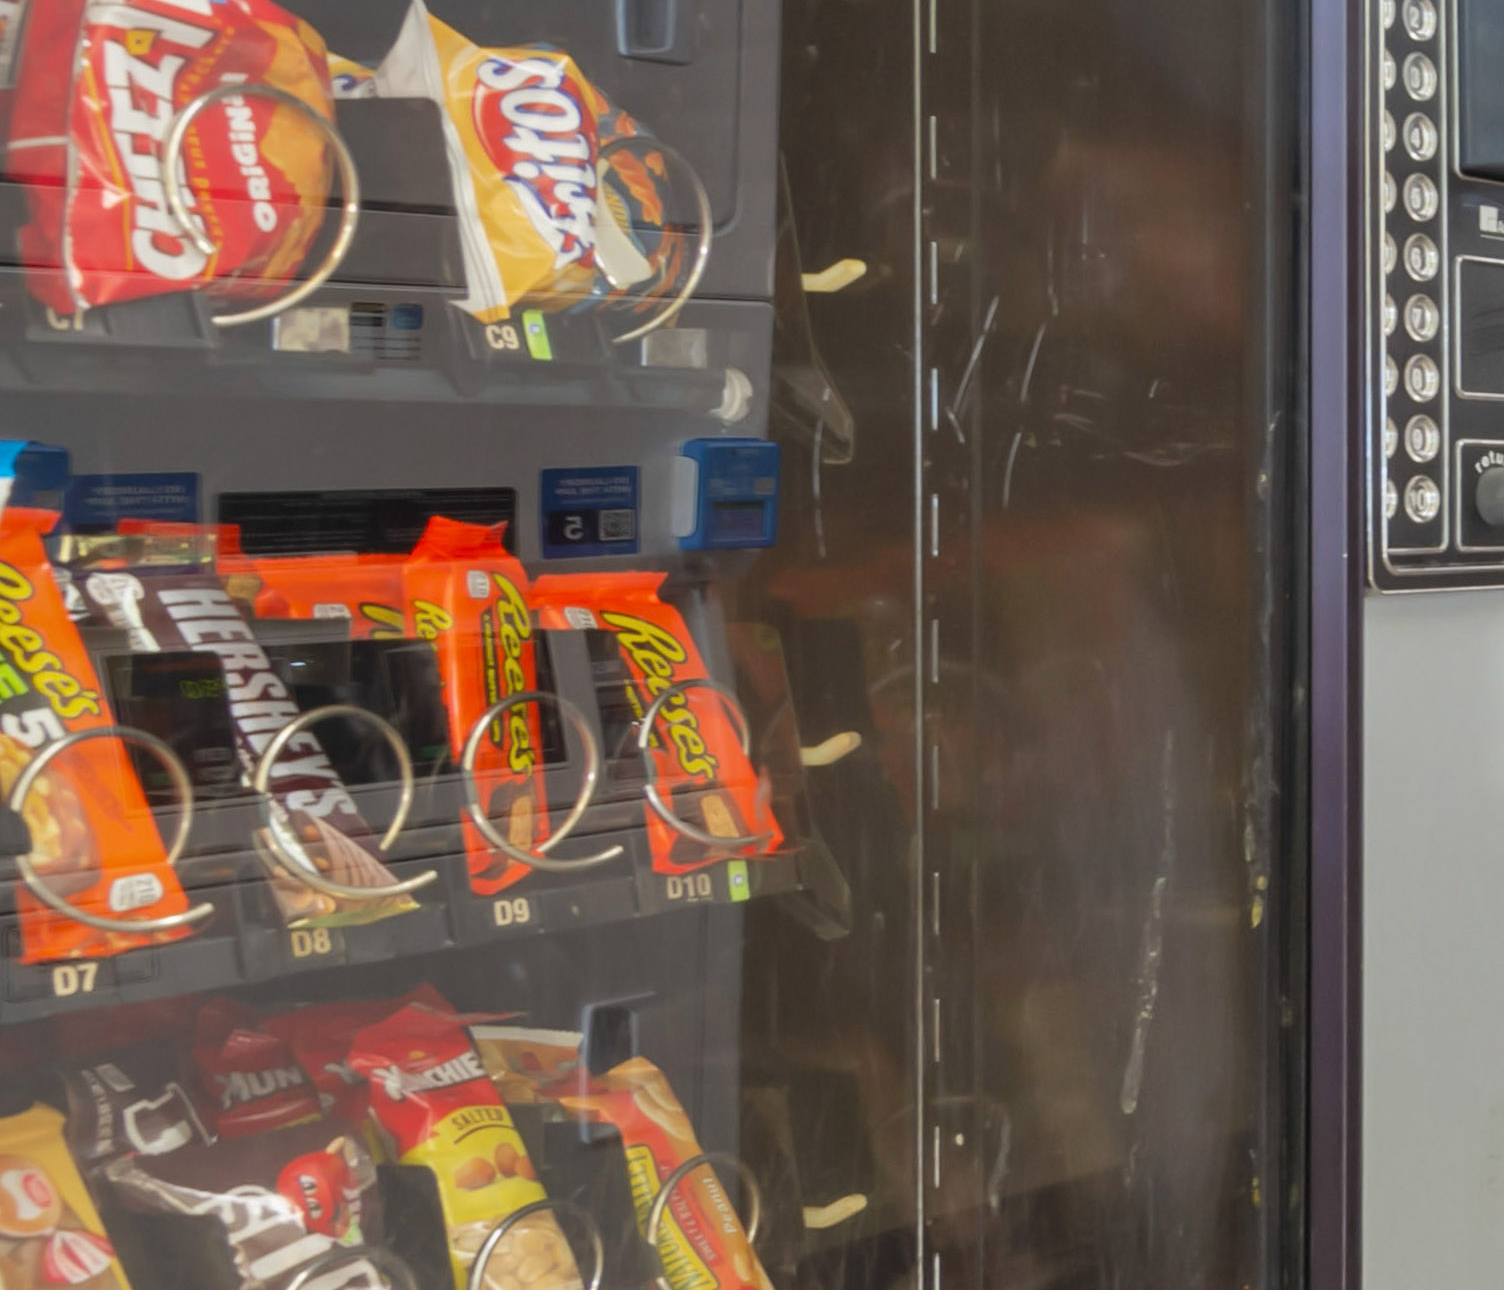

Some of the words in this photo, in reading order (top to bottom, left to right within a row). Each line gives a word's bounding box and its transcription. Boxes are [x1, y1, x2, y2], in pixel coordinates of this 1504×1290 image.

[220, 72, 279, 234] ORIGINL
[476, 57, 600, 271] Fritos
[485, 323, 520, 351] C9
[493, 572, 537, 778] Reese's
[601, 610, 720, 779] Reese's
[156, 587, 364, 818] HERSHEY'S
[666, 872, 712, 900] D10
[493, 897, 532, 926] D9
[290, 927, 332, 958] D8
[52, 961, 100, 999] D7
[450, 1104, 507, 1132] SALTED
[702, 1176, 738, 1236] Peanut
